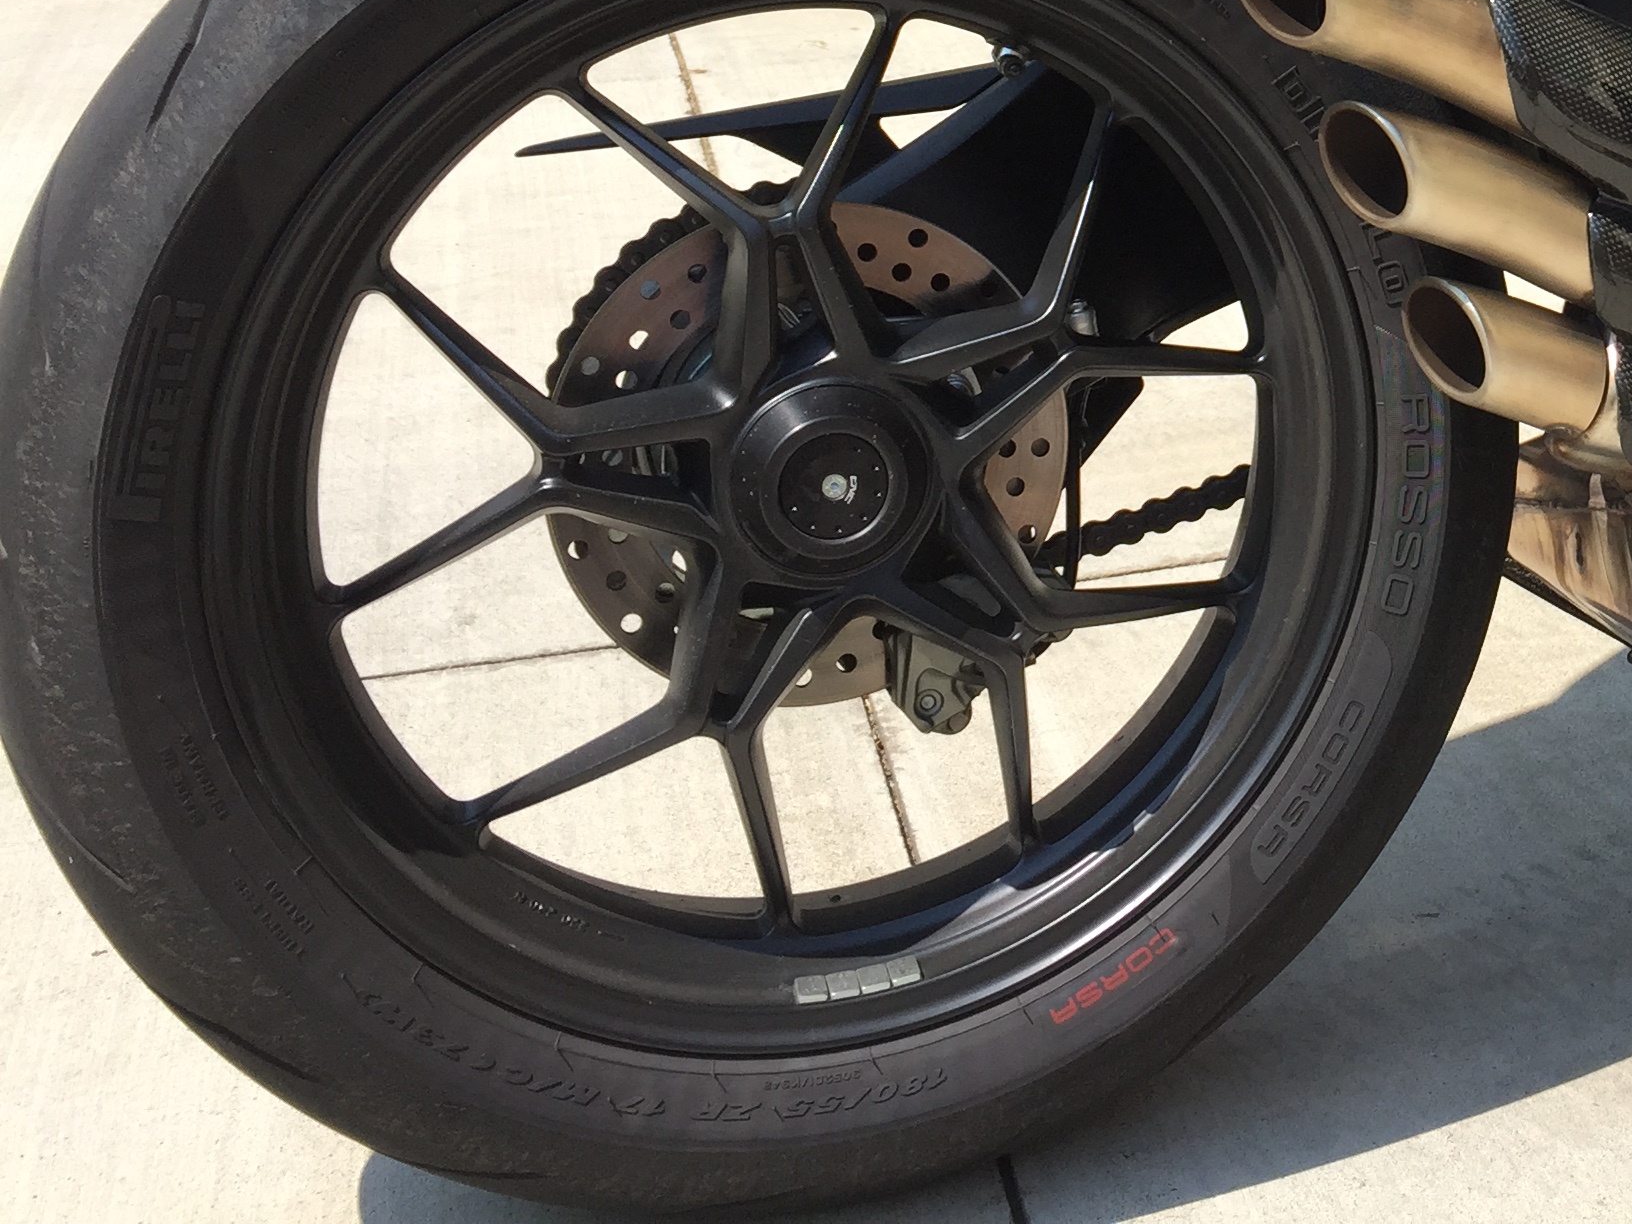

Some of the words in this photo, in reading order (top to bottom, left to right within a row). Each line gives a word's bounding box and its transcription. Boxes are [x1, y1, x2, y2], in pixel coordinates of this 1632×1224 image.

[106, 294, 206, 523] PIRELLI
[1382, 392, 1433, 618] ROSSO
[1257, 698, 1366, 859] CORSA
[1048, 927, 1178, 1026] CORSA
[690, 1101, 762, 1122] ZR
[783, 1067, 949, 1121] 180/55
